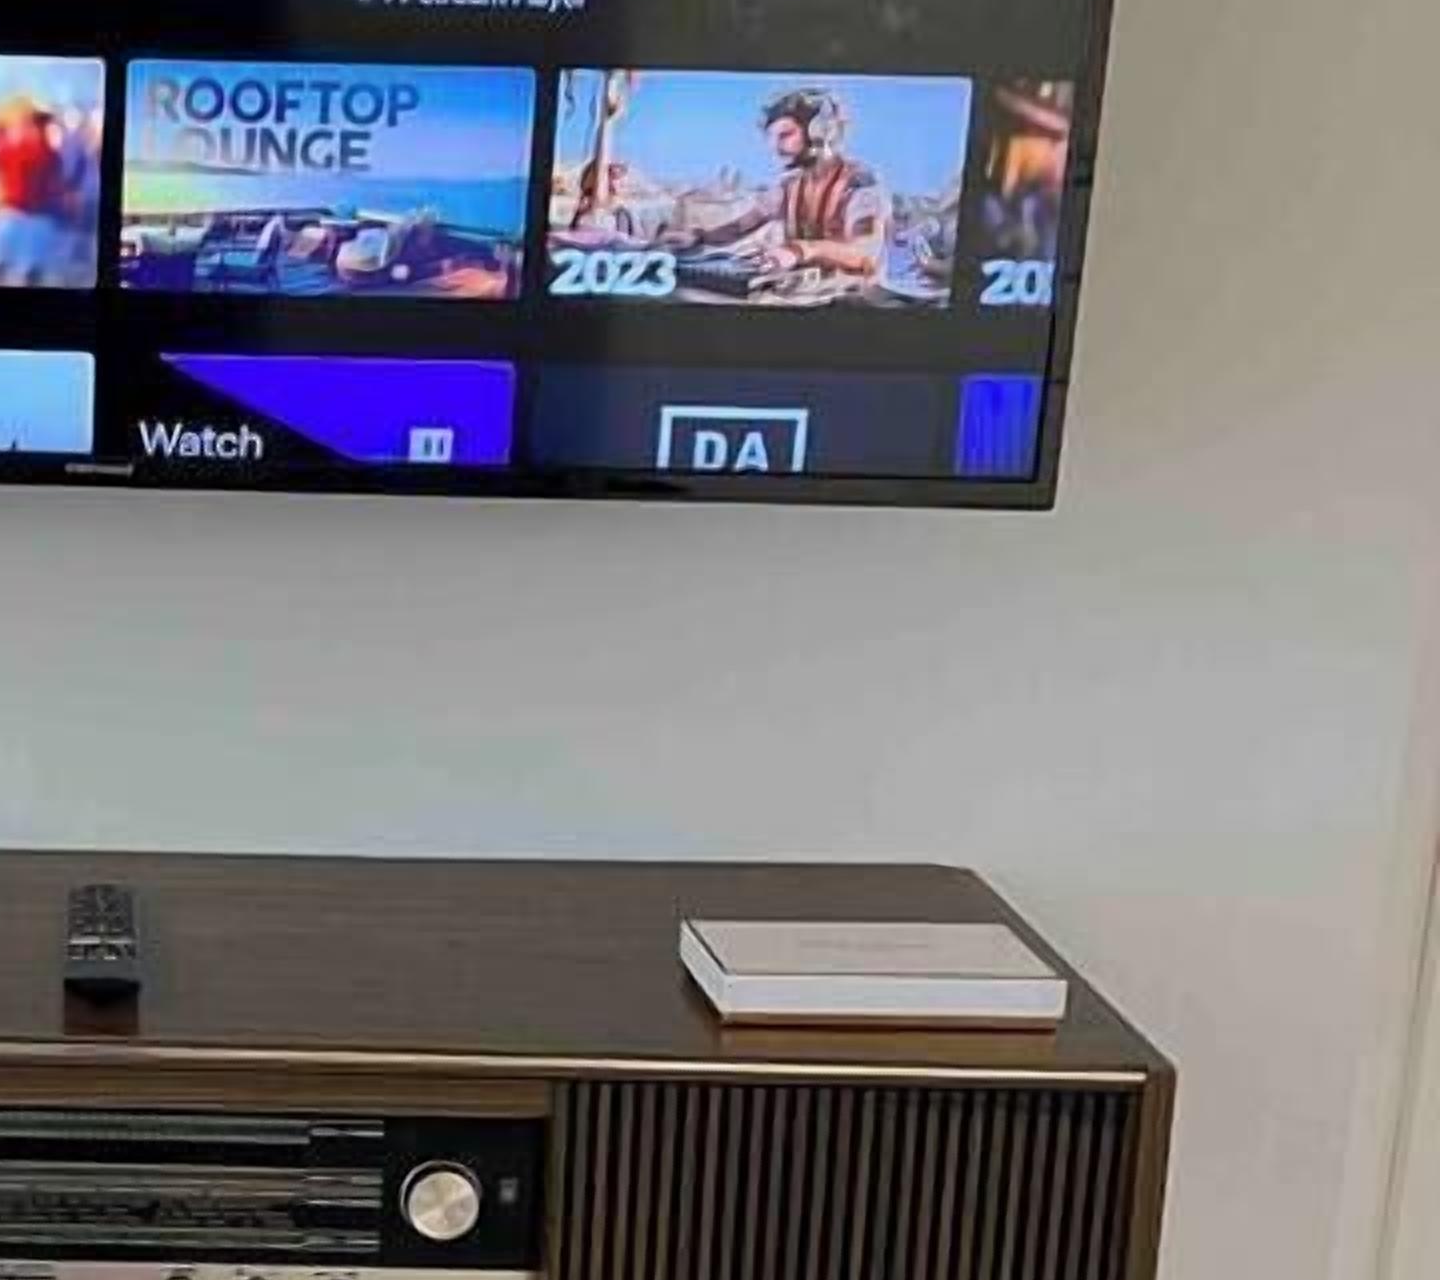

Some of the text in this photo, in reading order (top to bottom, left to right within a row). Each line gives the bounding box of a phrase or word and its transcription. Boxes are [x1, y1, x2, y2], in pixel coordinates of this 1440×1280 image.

[148, 76, 421, 128] ROOFTOP
[549, 250, 677, 297] 2023
[138, 421, 263, 460] Watch
